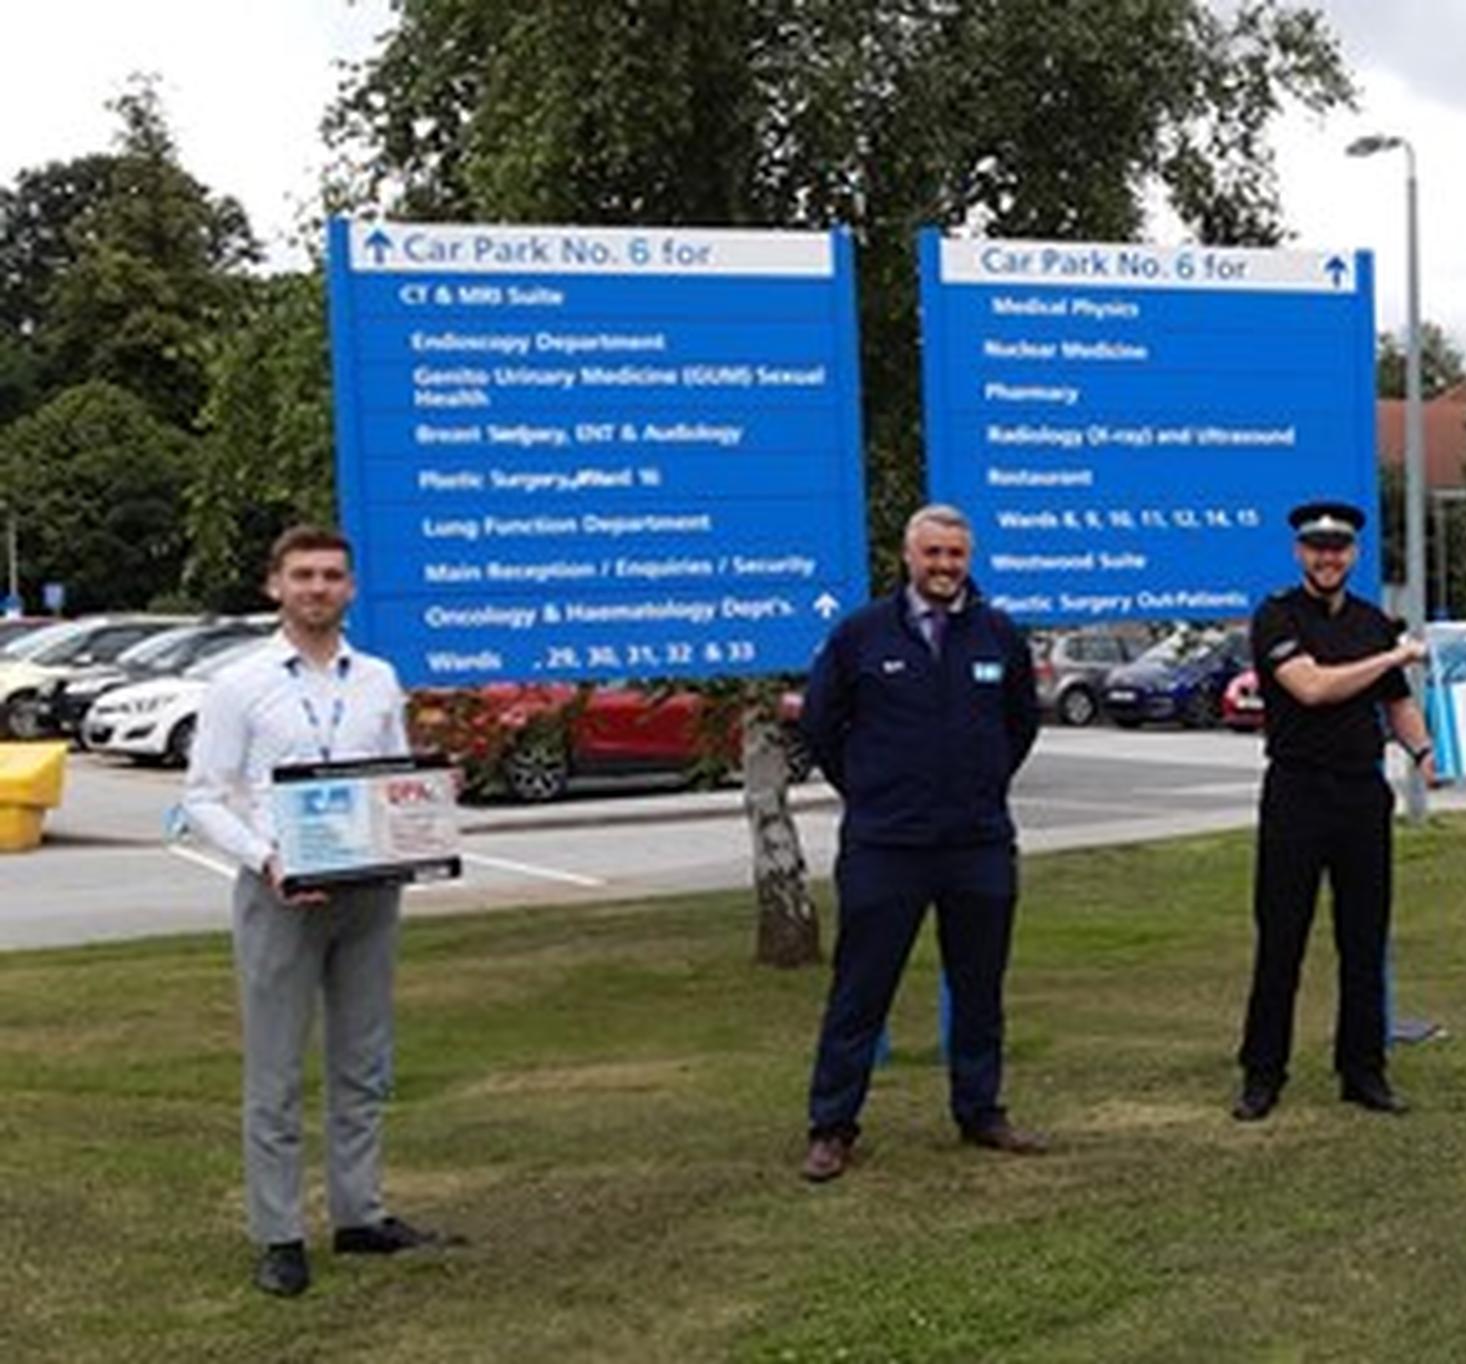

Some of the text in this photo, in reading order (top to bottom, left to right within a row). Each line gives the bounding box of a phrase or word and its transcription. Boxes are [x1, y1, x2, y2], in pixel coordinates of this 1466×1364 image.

[403, 234, 711, 267] Car Park No. 6 for
[981, 247, 1248, 280] Car Park No. 6 for
[435, 286, 453, 304] &
[507, 287, 563, 305] Suite
[992, 297, 1138, 320] Medical Physics
[412, 333, 664, 354] Endoscopy Department
[984, 341, 1146, 359] Nuclear Medicine
[413, 368, 490, 386] Genito
[494, 369, 576, 388] Urinary
[580, 368, 677, 385] Medicine
[756, 367, 824, 385] Sexual
[415, 389, 488, 407] Health
[985, 383, 1078, 405] Pharmacy
[416, 425, 481, 442] Breast
[621, 425, 637, 441] &
[644, 424, 741, 445] Audiology
[988, 426, 1083, 447] Radiology
[1157, 428, 1192, 444] and
[419, 471, 481, 488] Plastic
[988, 469, 1091, 486] Restaurant
[424, 515, 709, 539] Lung Function Department
[999, 512, 1058, 528] Wards
[425, 564, 481, 581] Main
[487, 562, 595, 582] Reception
[616, 560, 712, 579] Enquiries
[733, 556, 814, 577] Security
[991, 553, 1145, 570] Westwood Suite
[425, 604, 537, 628] Oncology
[543, 604, 561, 623] &
[566, 601, 716, 622] Haematology
[1060, 594, 1132, 614] Surgery
[428, 652, 501, 672] Wards
[705, 642, 722, 662] &
